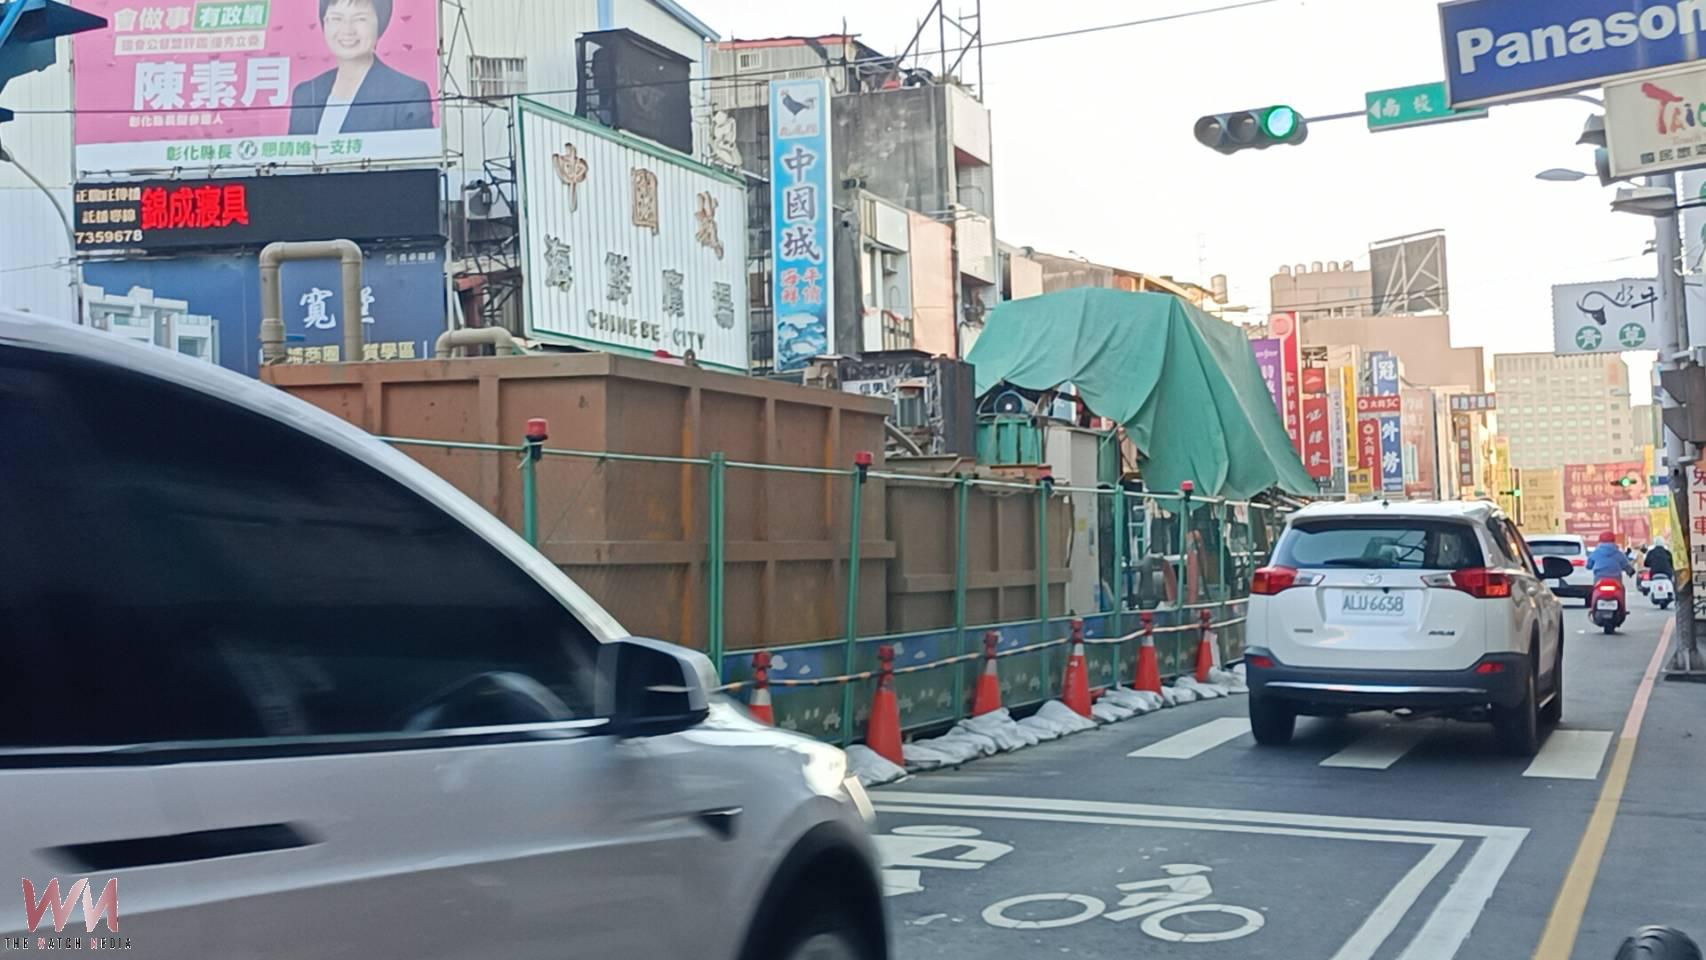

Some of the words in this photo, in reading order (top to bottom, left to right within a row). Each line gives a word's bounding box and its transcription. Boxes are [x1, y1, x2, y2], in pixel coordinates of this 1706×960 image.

[114, 7, 191, 32] 會做事
[133, 57, 290, 110] 陳素月
[166, 143, 233, 161] 彰化縣長
[141, 184, 248, 229] 錦成寢具
[782, 147, 821, 260] 中國城
[75, 229, 143, 244] 7359678
[672, 327, 705, 350] CITY
